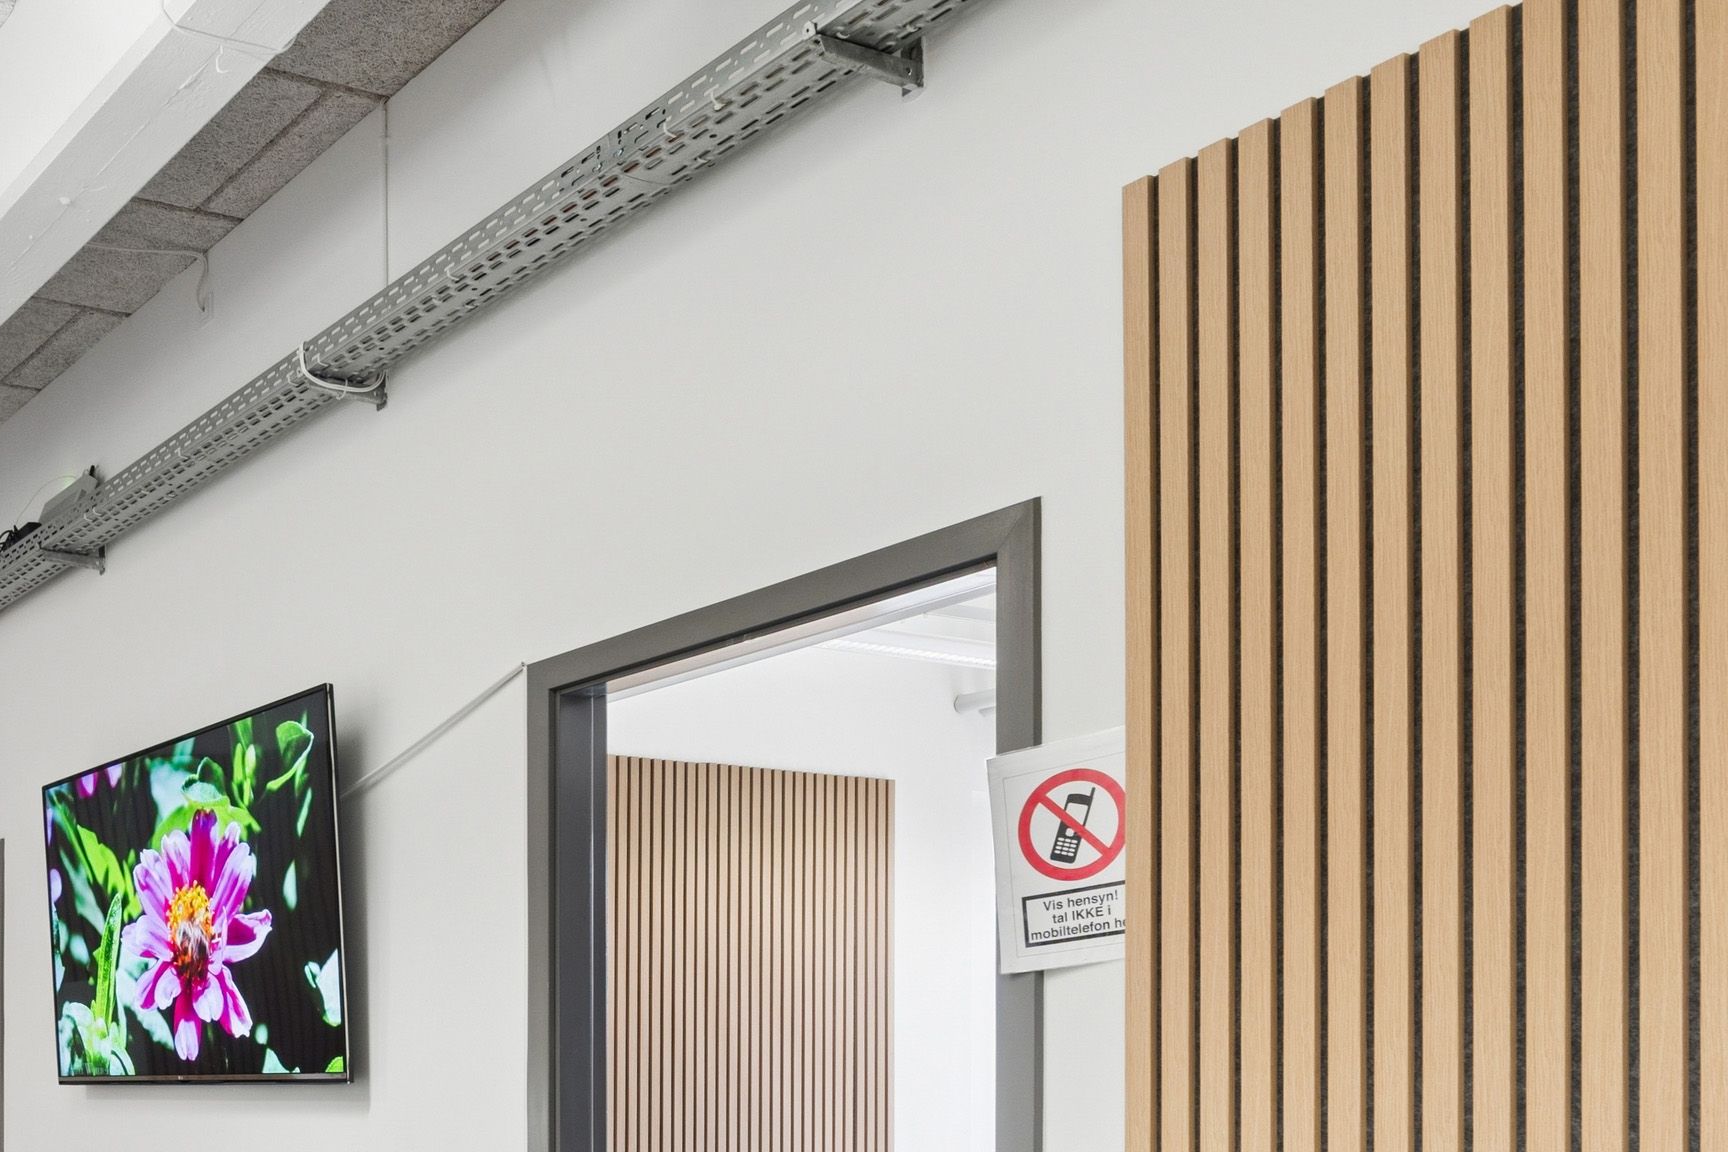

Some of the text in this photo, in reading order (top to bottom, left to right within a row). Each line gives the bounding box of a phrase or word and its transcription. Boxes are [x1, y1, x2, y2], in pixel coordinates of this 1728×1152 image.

[1043, 890, 1118, 911] Vis hensyn!
[1052, 905, 1111, 924] tal IKKE i
[1032, 921, 1110, 940] mobiltelefon
